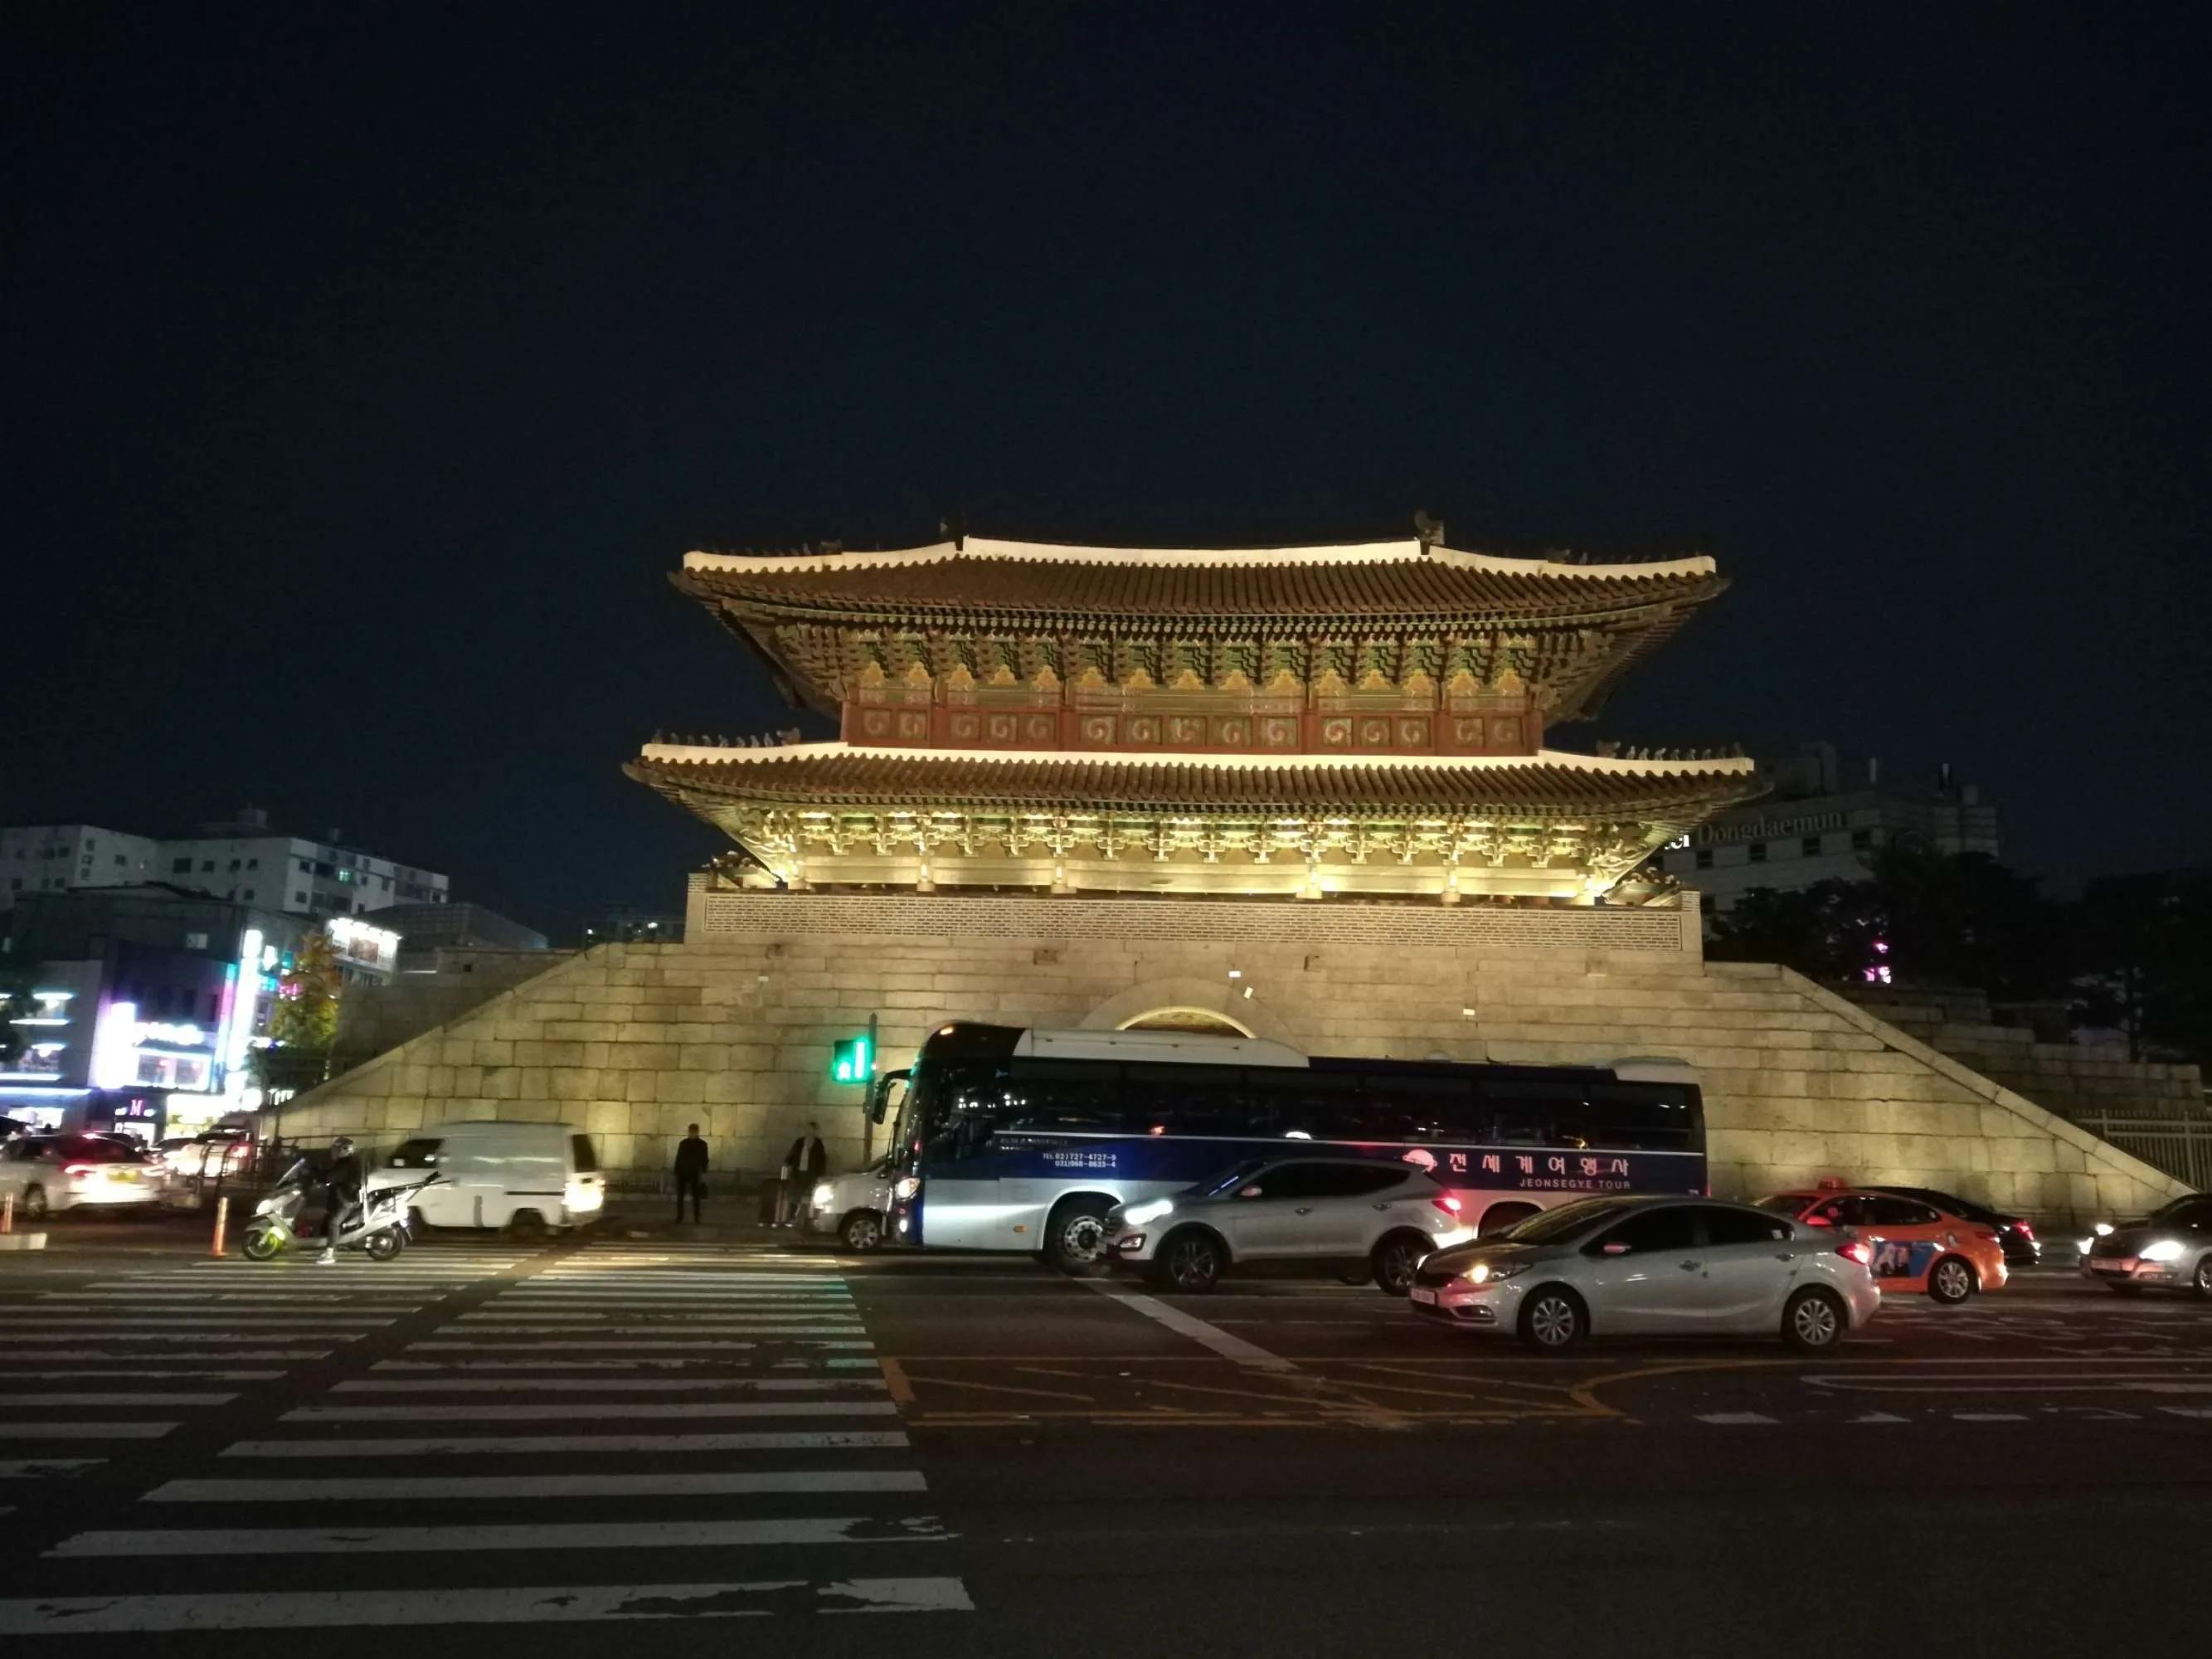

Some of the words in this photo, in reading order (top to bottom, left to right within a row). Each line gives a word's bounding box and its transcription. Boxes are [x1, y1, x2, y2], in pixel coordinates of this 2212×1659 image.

[1699, 810, 1843, 844] Dongdaemun
[1519, 1178, 1593, 1189] JEONSEGYE
[1598, 1180, 1631, 1190] TOUR
